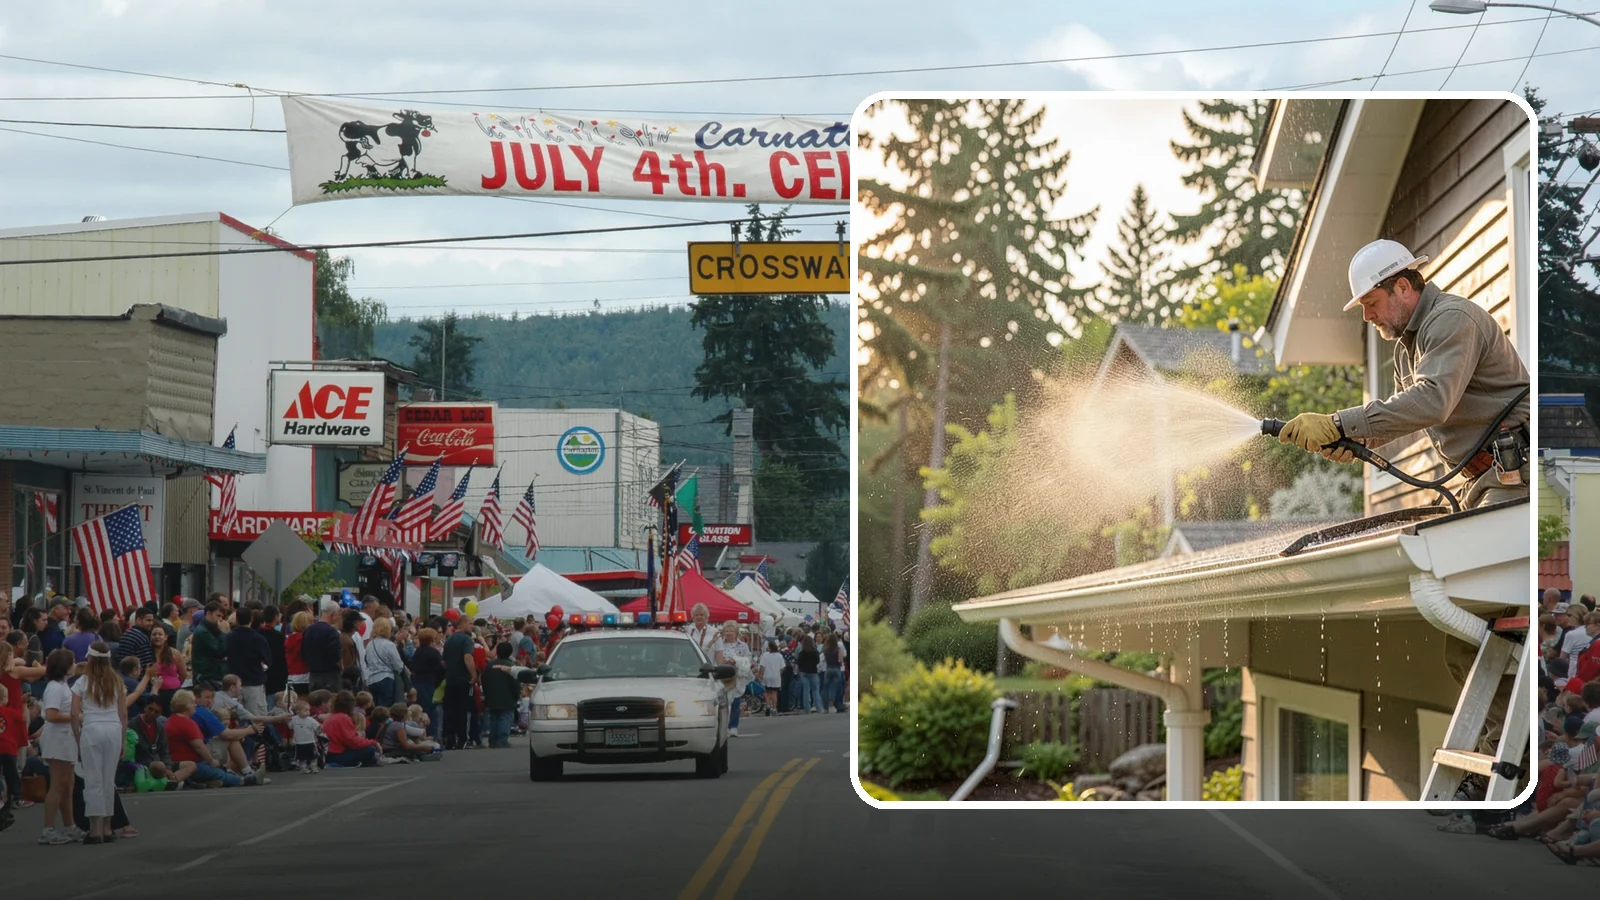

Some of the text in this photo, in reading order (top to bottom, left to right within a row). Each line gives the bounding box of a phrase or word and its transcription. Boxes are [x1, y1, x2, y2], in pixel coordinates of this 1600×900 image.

[481, 141, 604, 192] JULY
[632, 149, 746, 198] 4th.
[696, 253, 850, 280] CROSSWA
[282, 379, 374, 420] ACE
[405, 408, 453, 422] CEDAR
[283, 420, 371, 437] Hardware
[416, 427, 478, 447] Coca-Cola
[353, 466, 384, 480] Simpl
[83, 484, 155, 496] St. Vincent de Paul
[212, 515, 331, 536] HARDARE
[688, 526, 742, 535] CRNATION
[699, 535, 730, 543] GLASS
